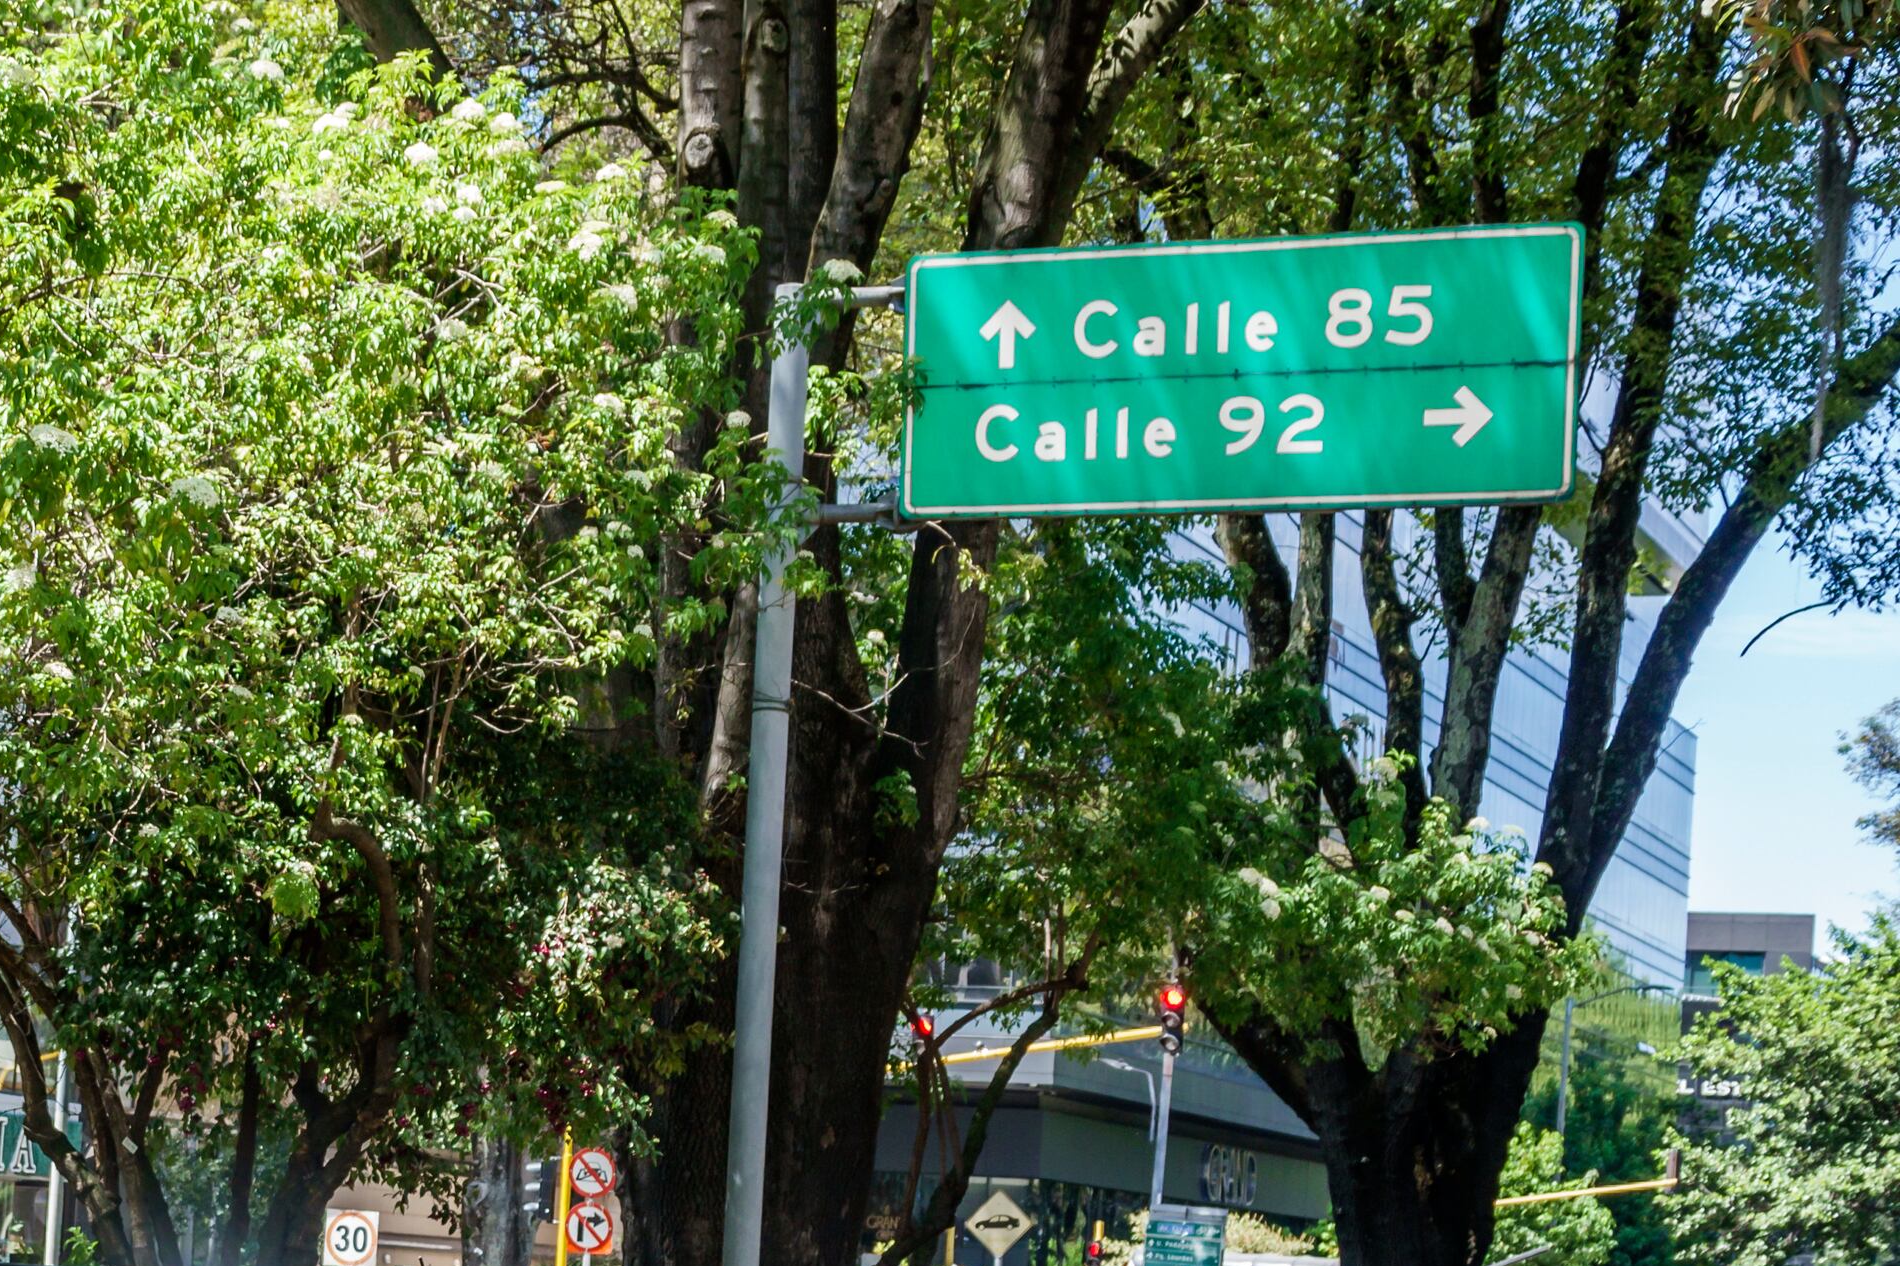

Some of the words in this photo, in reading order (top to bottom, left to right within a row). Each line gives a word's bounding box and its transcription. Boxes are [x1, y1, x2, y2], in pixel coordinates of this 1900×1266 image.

[1074, 300, 1279, 359] Calle
[1324, 284, 1433, 349] 85
[974, 403, 1177, 463] Calle
[1218, 393, 1325, 457] 92
[335, 1225, 368, 1253] 30
